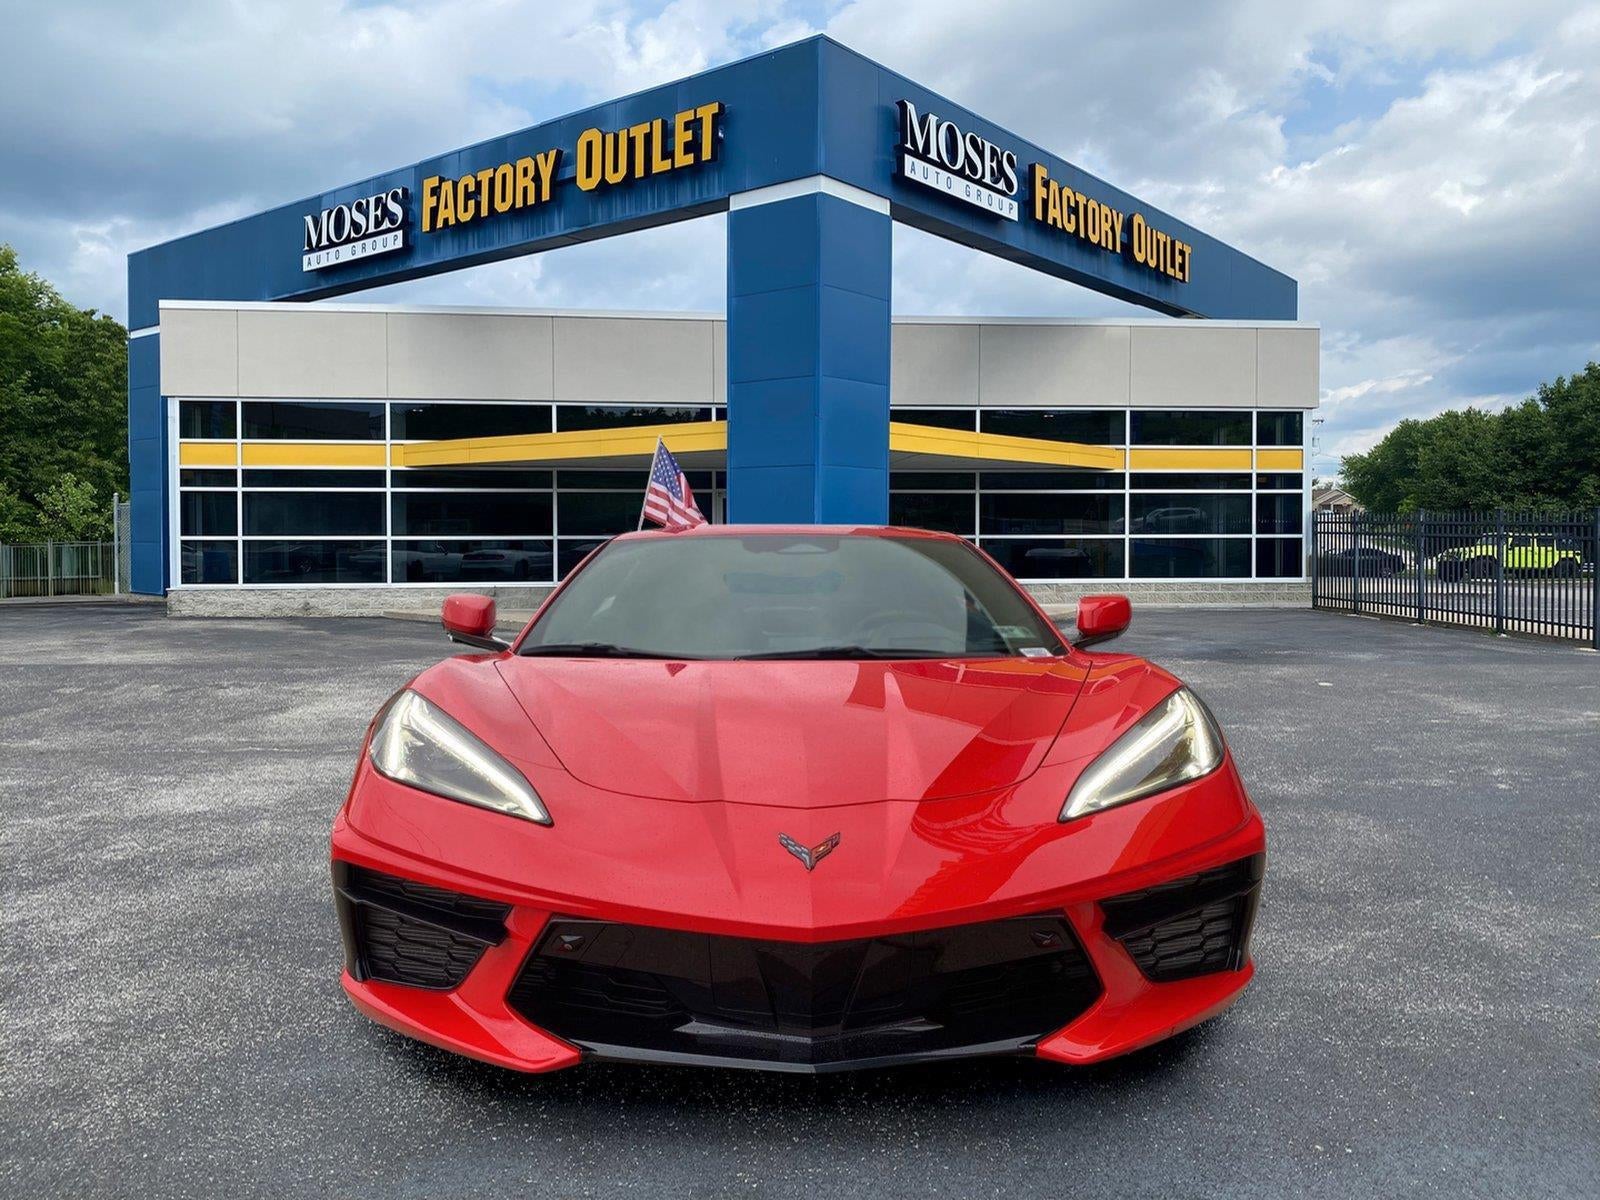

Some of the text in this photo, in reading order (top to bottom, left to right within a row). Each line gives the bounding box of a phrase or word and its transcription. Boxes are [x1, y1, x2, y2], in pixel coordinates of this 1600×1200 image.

[422, 101, 721, 233] FACTORY OUTLET
[904, 99, 1018, 196] MOSES
[303, 188, 404, 251] MOSES
[910, 162, 1015, 214] AUTO GROUP
[1034, 163, 1192, 283] FACTORY OUTLET
[307, 234, 399, 267] AUTO GROUP
